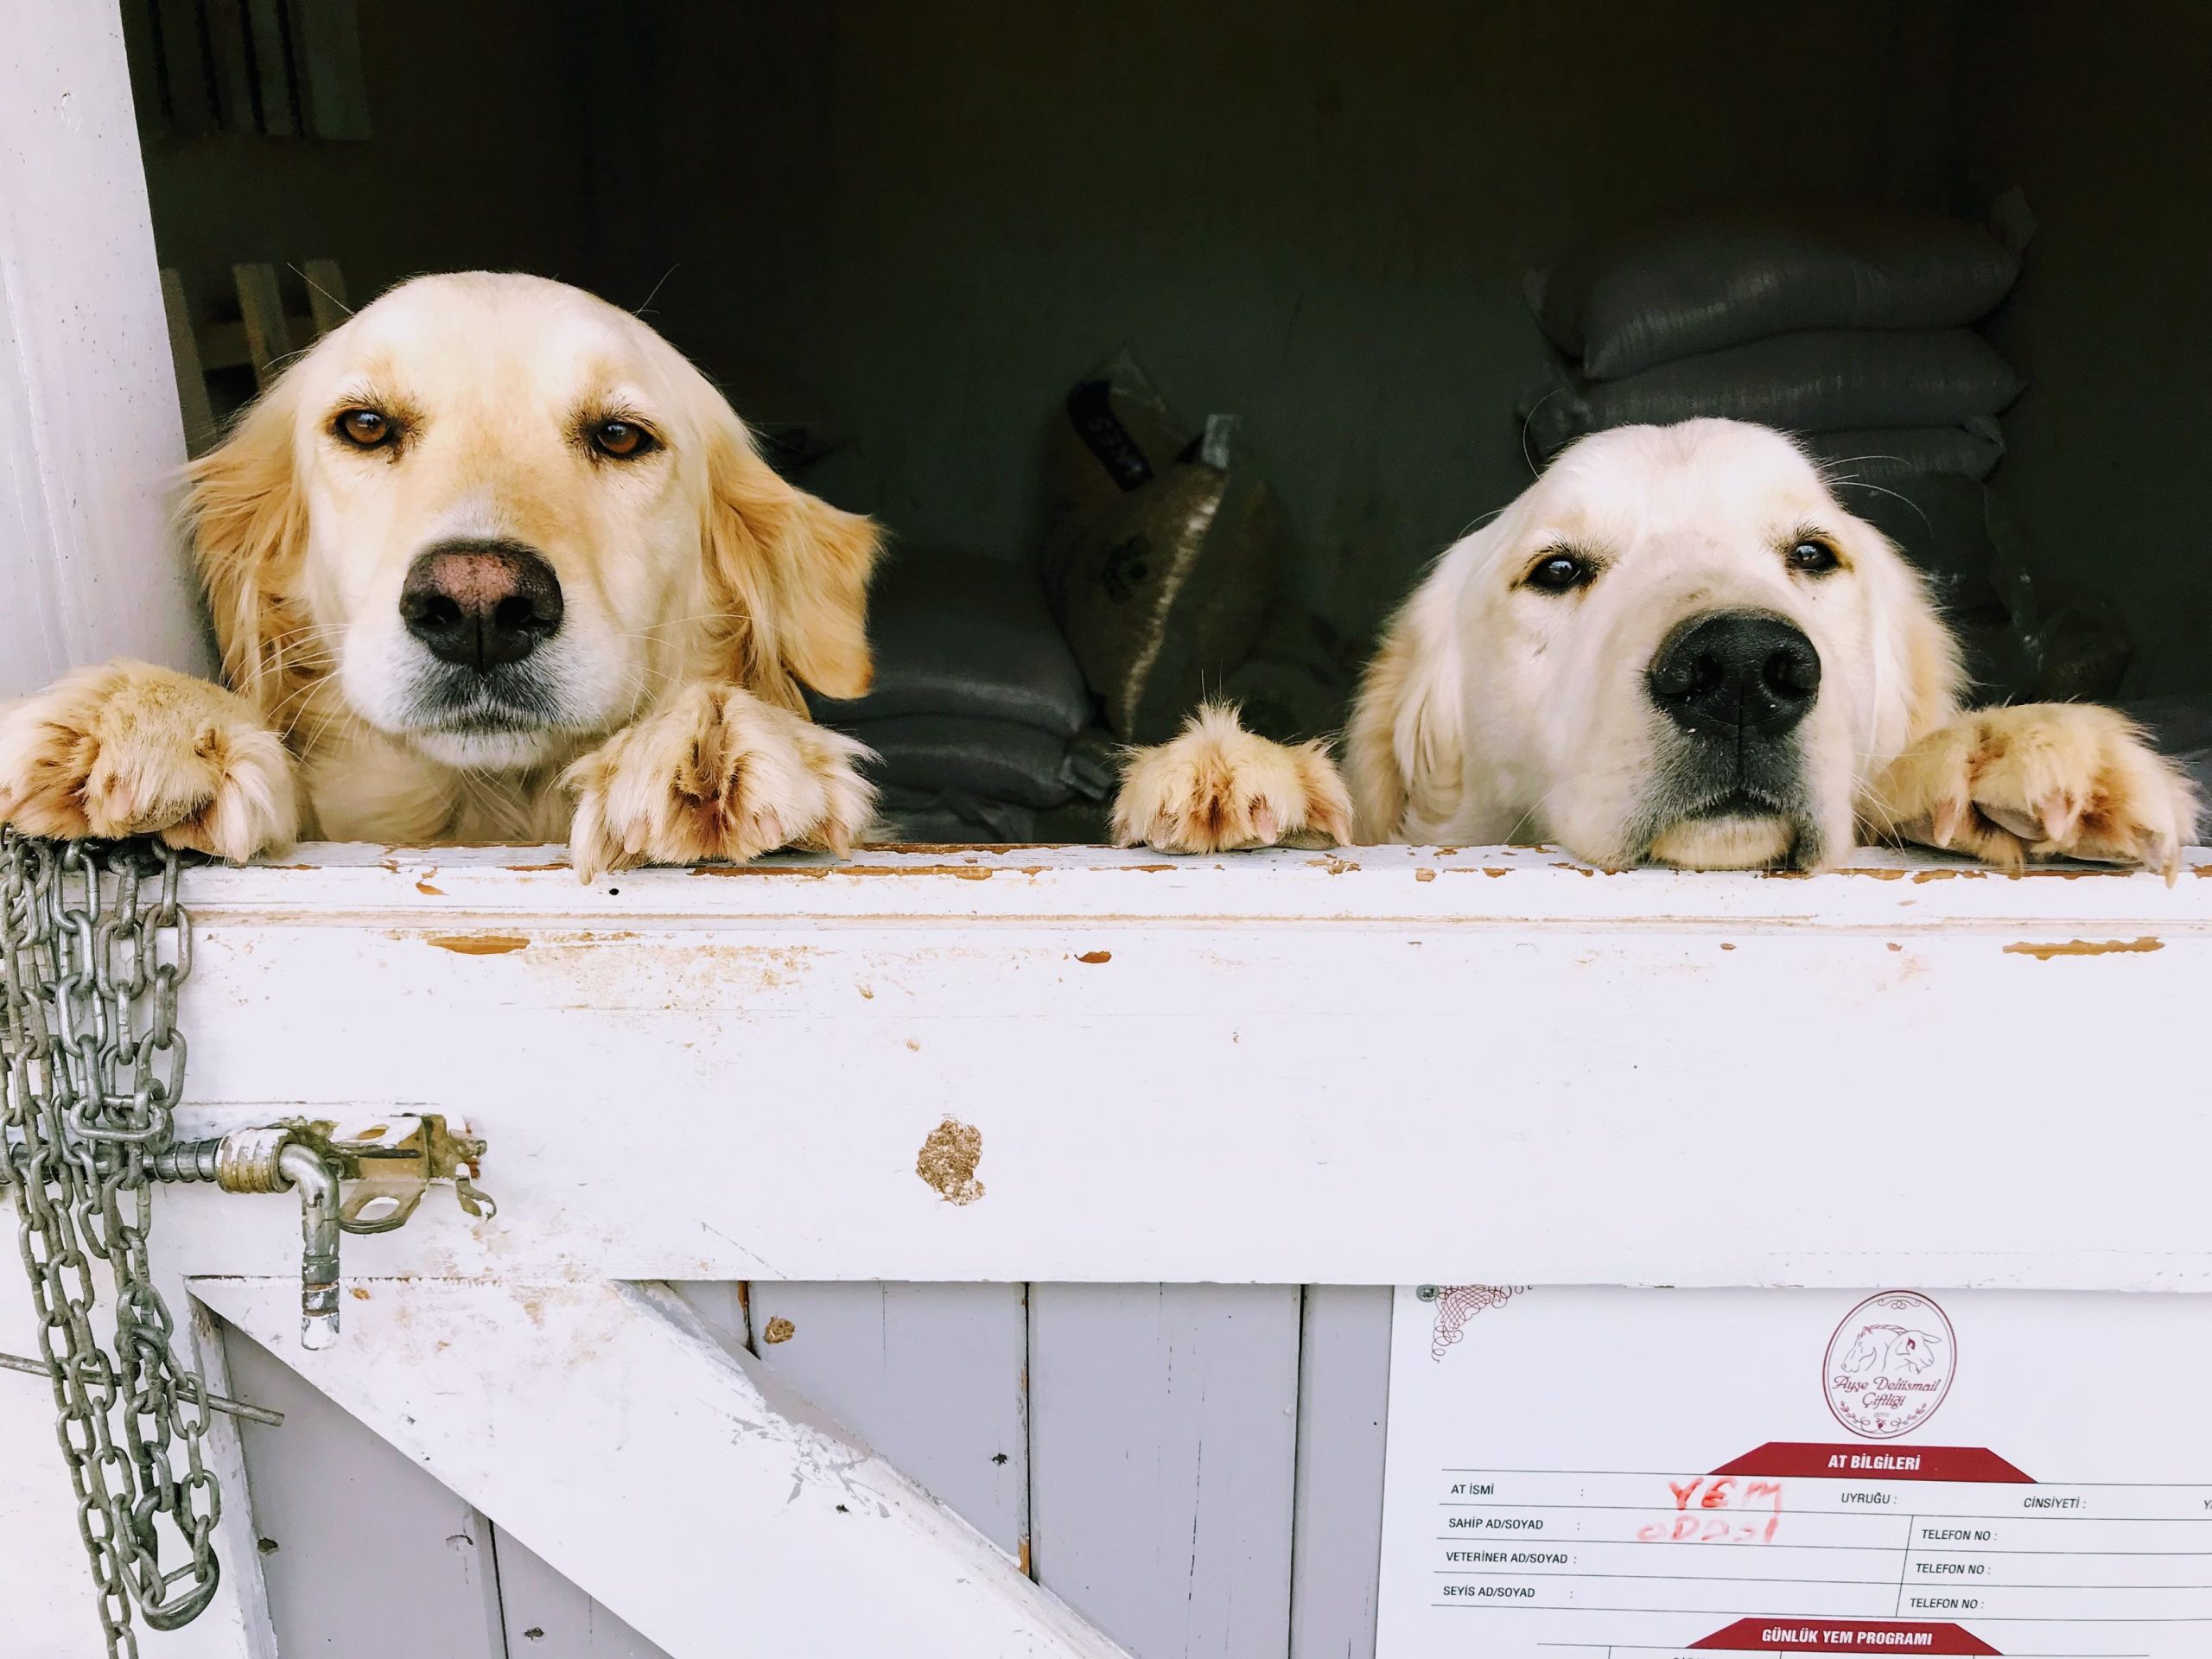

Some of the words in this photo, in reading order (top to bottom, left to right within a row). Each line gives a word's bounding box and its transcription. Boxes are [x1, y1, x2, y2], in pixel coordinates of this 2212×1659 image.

[1832, 1375, 1868, 1393] Ayşe
[1862, 1392, 1906, 1409] Çiftliği
[1827, 1454, 1847, 1468] AT
[1850, 1452, 1921, 1471] BİLGİLERİ
[1451, 1484, 1466, 1494] AT
[1469, 1483, 1494, 1495] İSMİ
[1669, 1477, 1782, 1516] YEM
[1841, 1492, 1891, 1504] UYRUĞU
[2024, 1496, 2081, 1509] CİNSİYETİ
[1448, 1516, 1483, 1529] SAHİP
[1485, 1519, 1543, 1529] AD/SOYAD
[1922, 1529, 1971, 1540] TELEFON
[1974, 1530, 1991, 1541] NO
[1446, 1550, 1507, 1563] VETERİNER
[1510, 1553, 1568, 1564] AD/SOYAD
[1916, 1563, 1965, 1573] TELEFON
[1967, 1564, 1985, 1574] NO
[1443, 1585, 1475, 1597] SEYİS
[1478, 1586, 1535, 1598] AD/SOYAD
[1910, 1598, 1959, 1608] TELEFON
[1961, 1599, 1978, 1609] NO
[1762, 1627, 1819, 1643] GÜNLÜK
[1822, 1630, 1853, 1643] YEM
[1857, 1631, 1932, 1645] PROGRAMI
